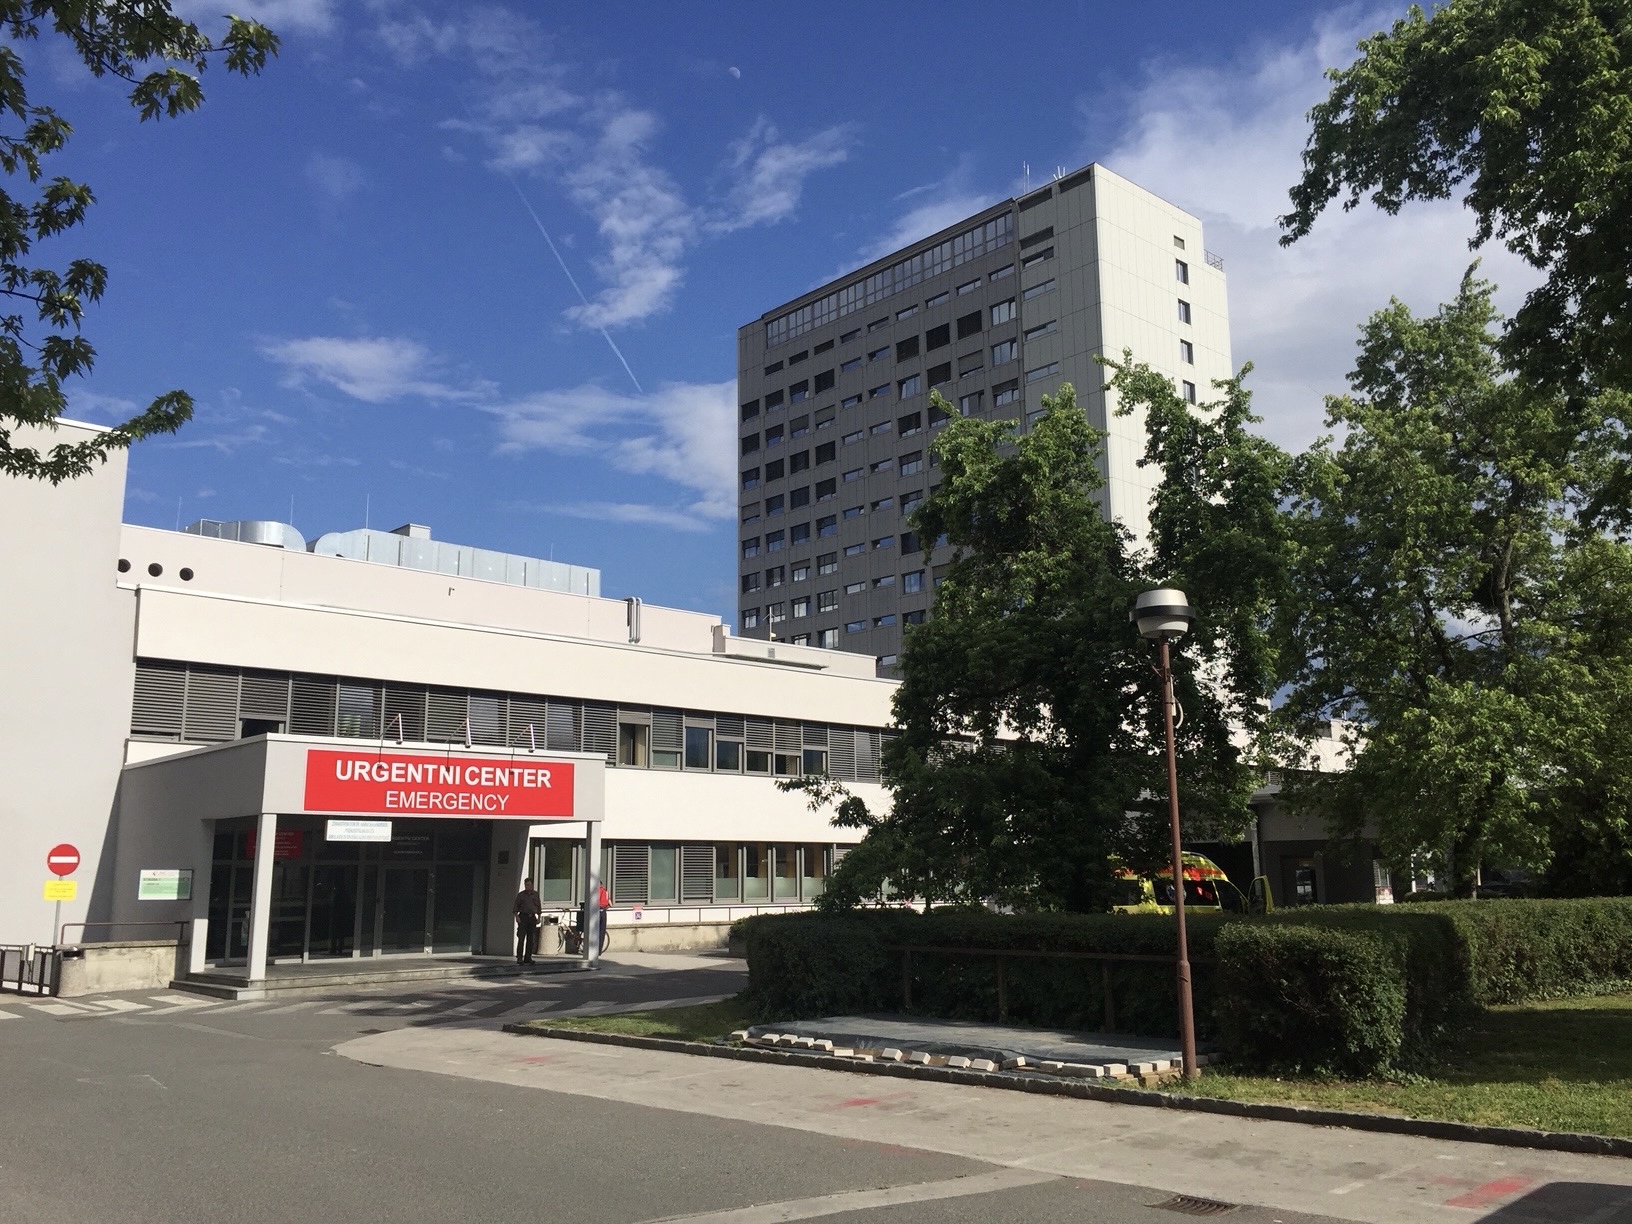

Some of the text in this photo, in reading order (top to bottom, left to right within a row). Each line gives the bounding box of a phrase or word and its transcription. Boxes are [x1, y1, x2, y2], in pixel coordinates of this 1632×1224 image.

[335, 759, 552, 788] URGENTNI CENTER
[385, 790, 510, 811] EMERGENCY
